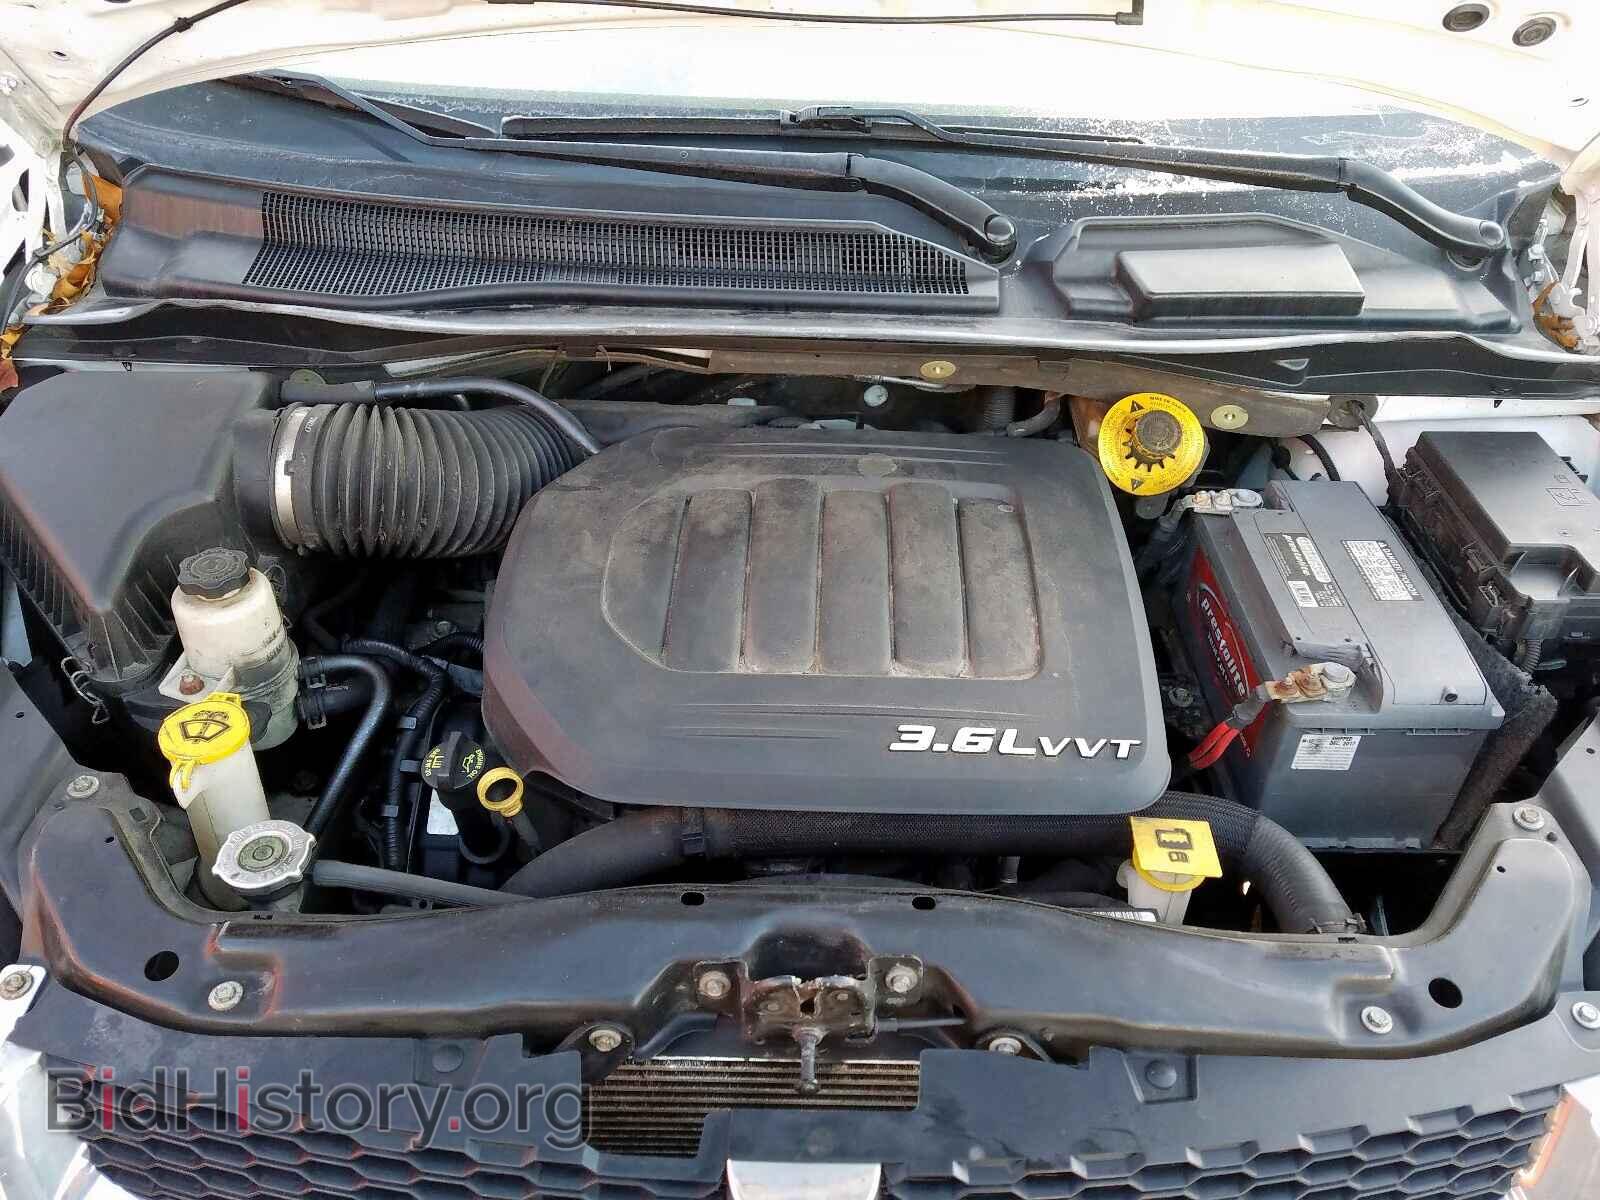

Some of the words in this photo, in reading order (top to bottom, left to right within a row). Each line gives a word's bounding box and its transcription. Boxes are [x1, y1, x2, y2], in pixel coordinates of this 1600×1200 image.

[1201, 598, 1246, 697] prestolite
[889, 724, 1037, 756] 3.6L
[1038, 736, 1142, 759] VVT
[475, 748, 484, 770] ENGINE
[467, 769, 478, 780] OIL
